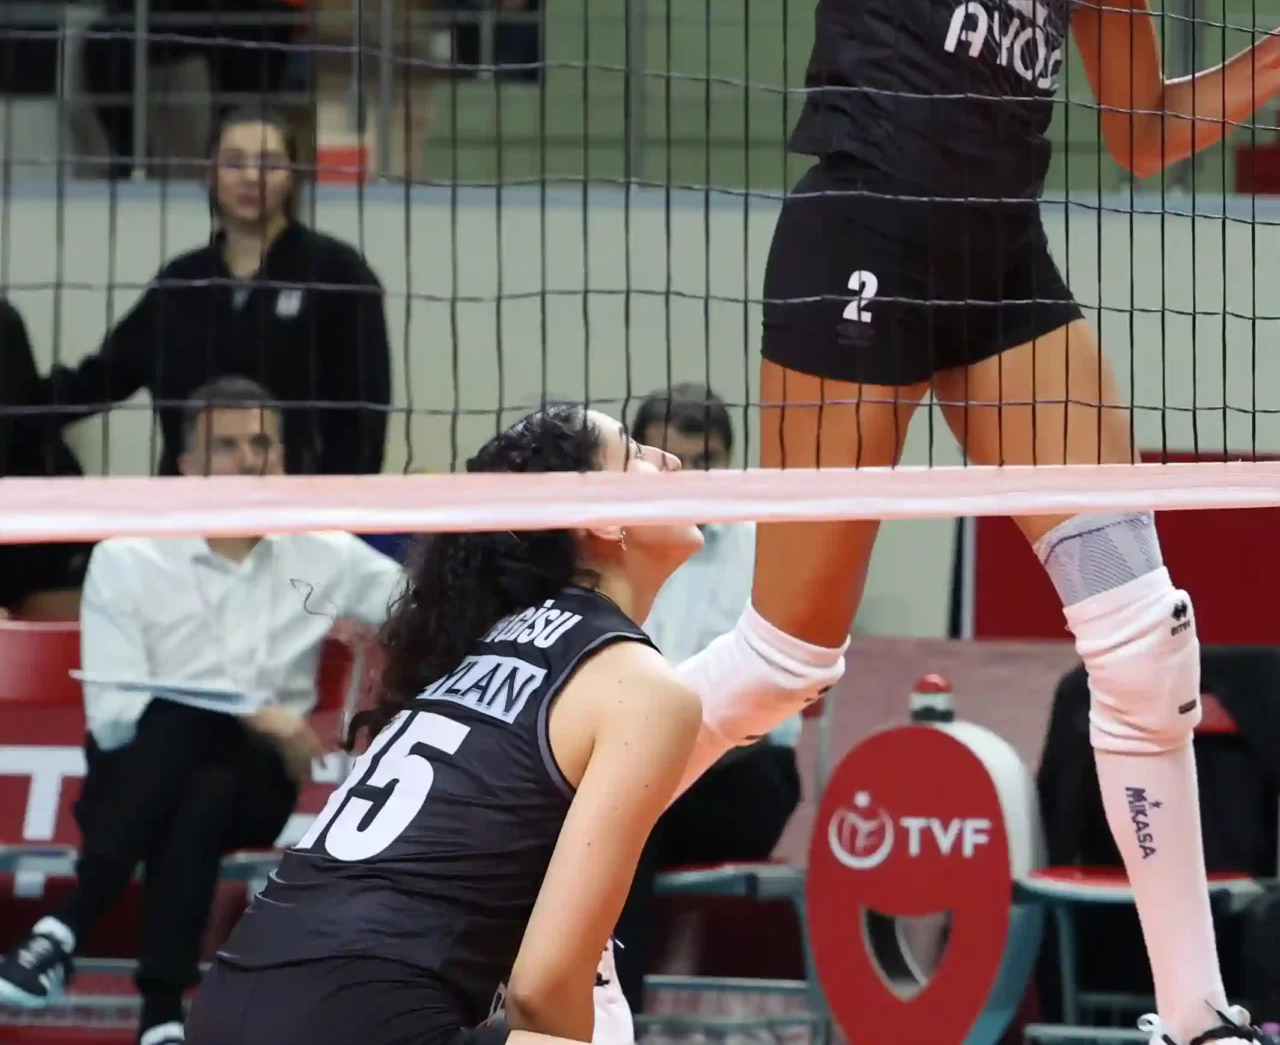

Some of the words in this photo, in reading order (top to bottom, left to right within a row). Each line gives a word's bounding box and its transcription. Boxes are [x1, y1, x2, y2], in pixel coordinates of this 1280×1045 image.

[842, 269, 878, 323] 2
[899, 815, 992, 859] TVF
[1125, 786, 1157, 860] MIKASA
